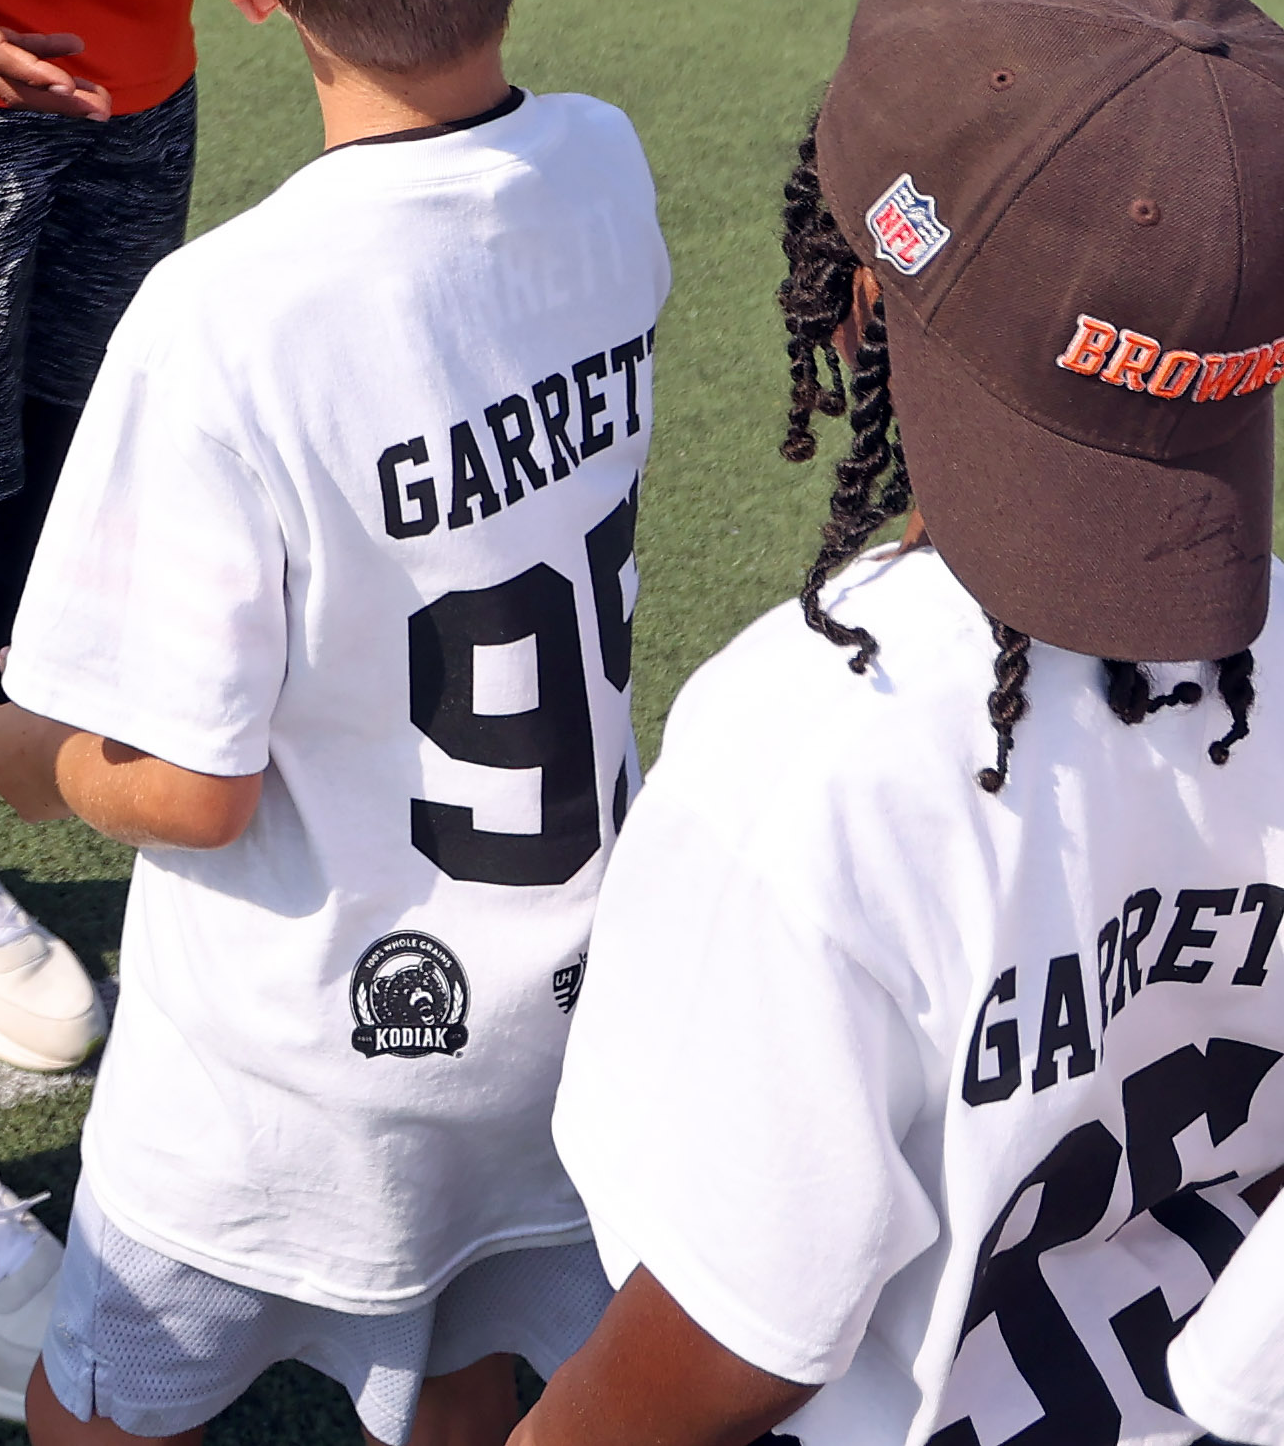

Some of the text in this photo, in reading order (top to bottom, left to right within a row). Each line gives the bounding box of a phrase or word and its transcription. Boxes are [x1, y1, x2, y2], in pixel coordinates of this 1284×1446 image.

[875, 202, 922, 264] NFL
[377, 322, 656, 540] GARRET
[364, 939, 452, 969] 100% WHOLE GRAINS
[375, 1027, 448, 1051] KODIAK
